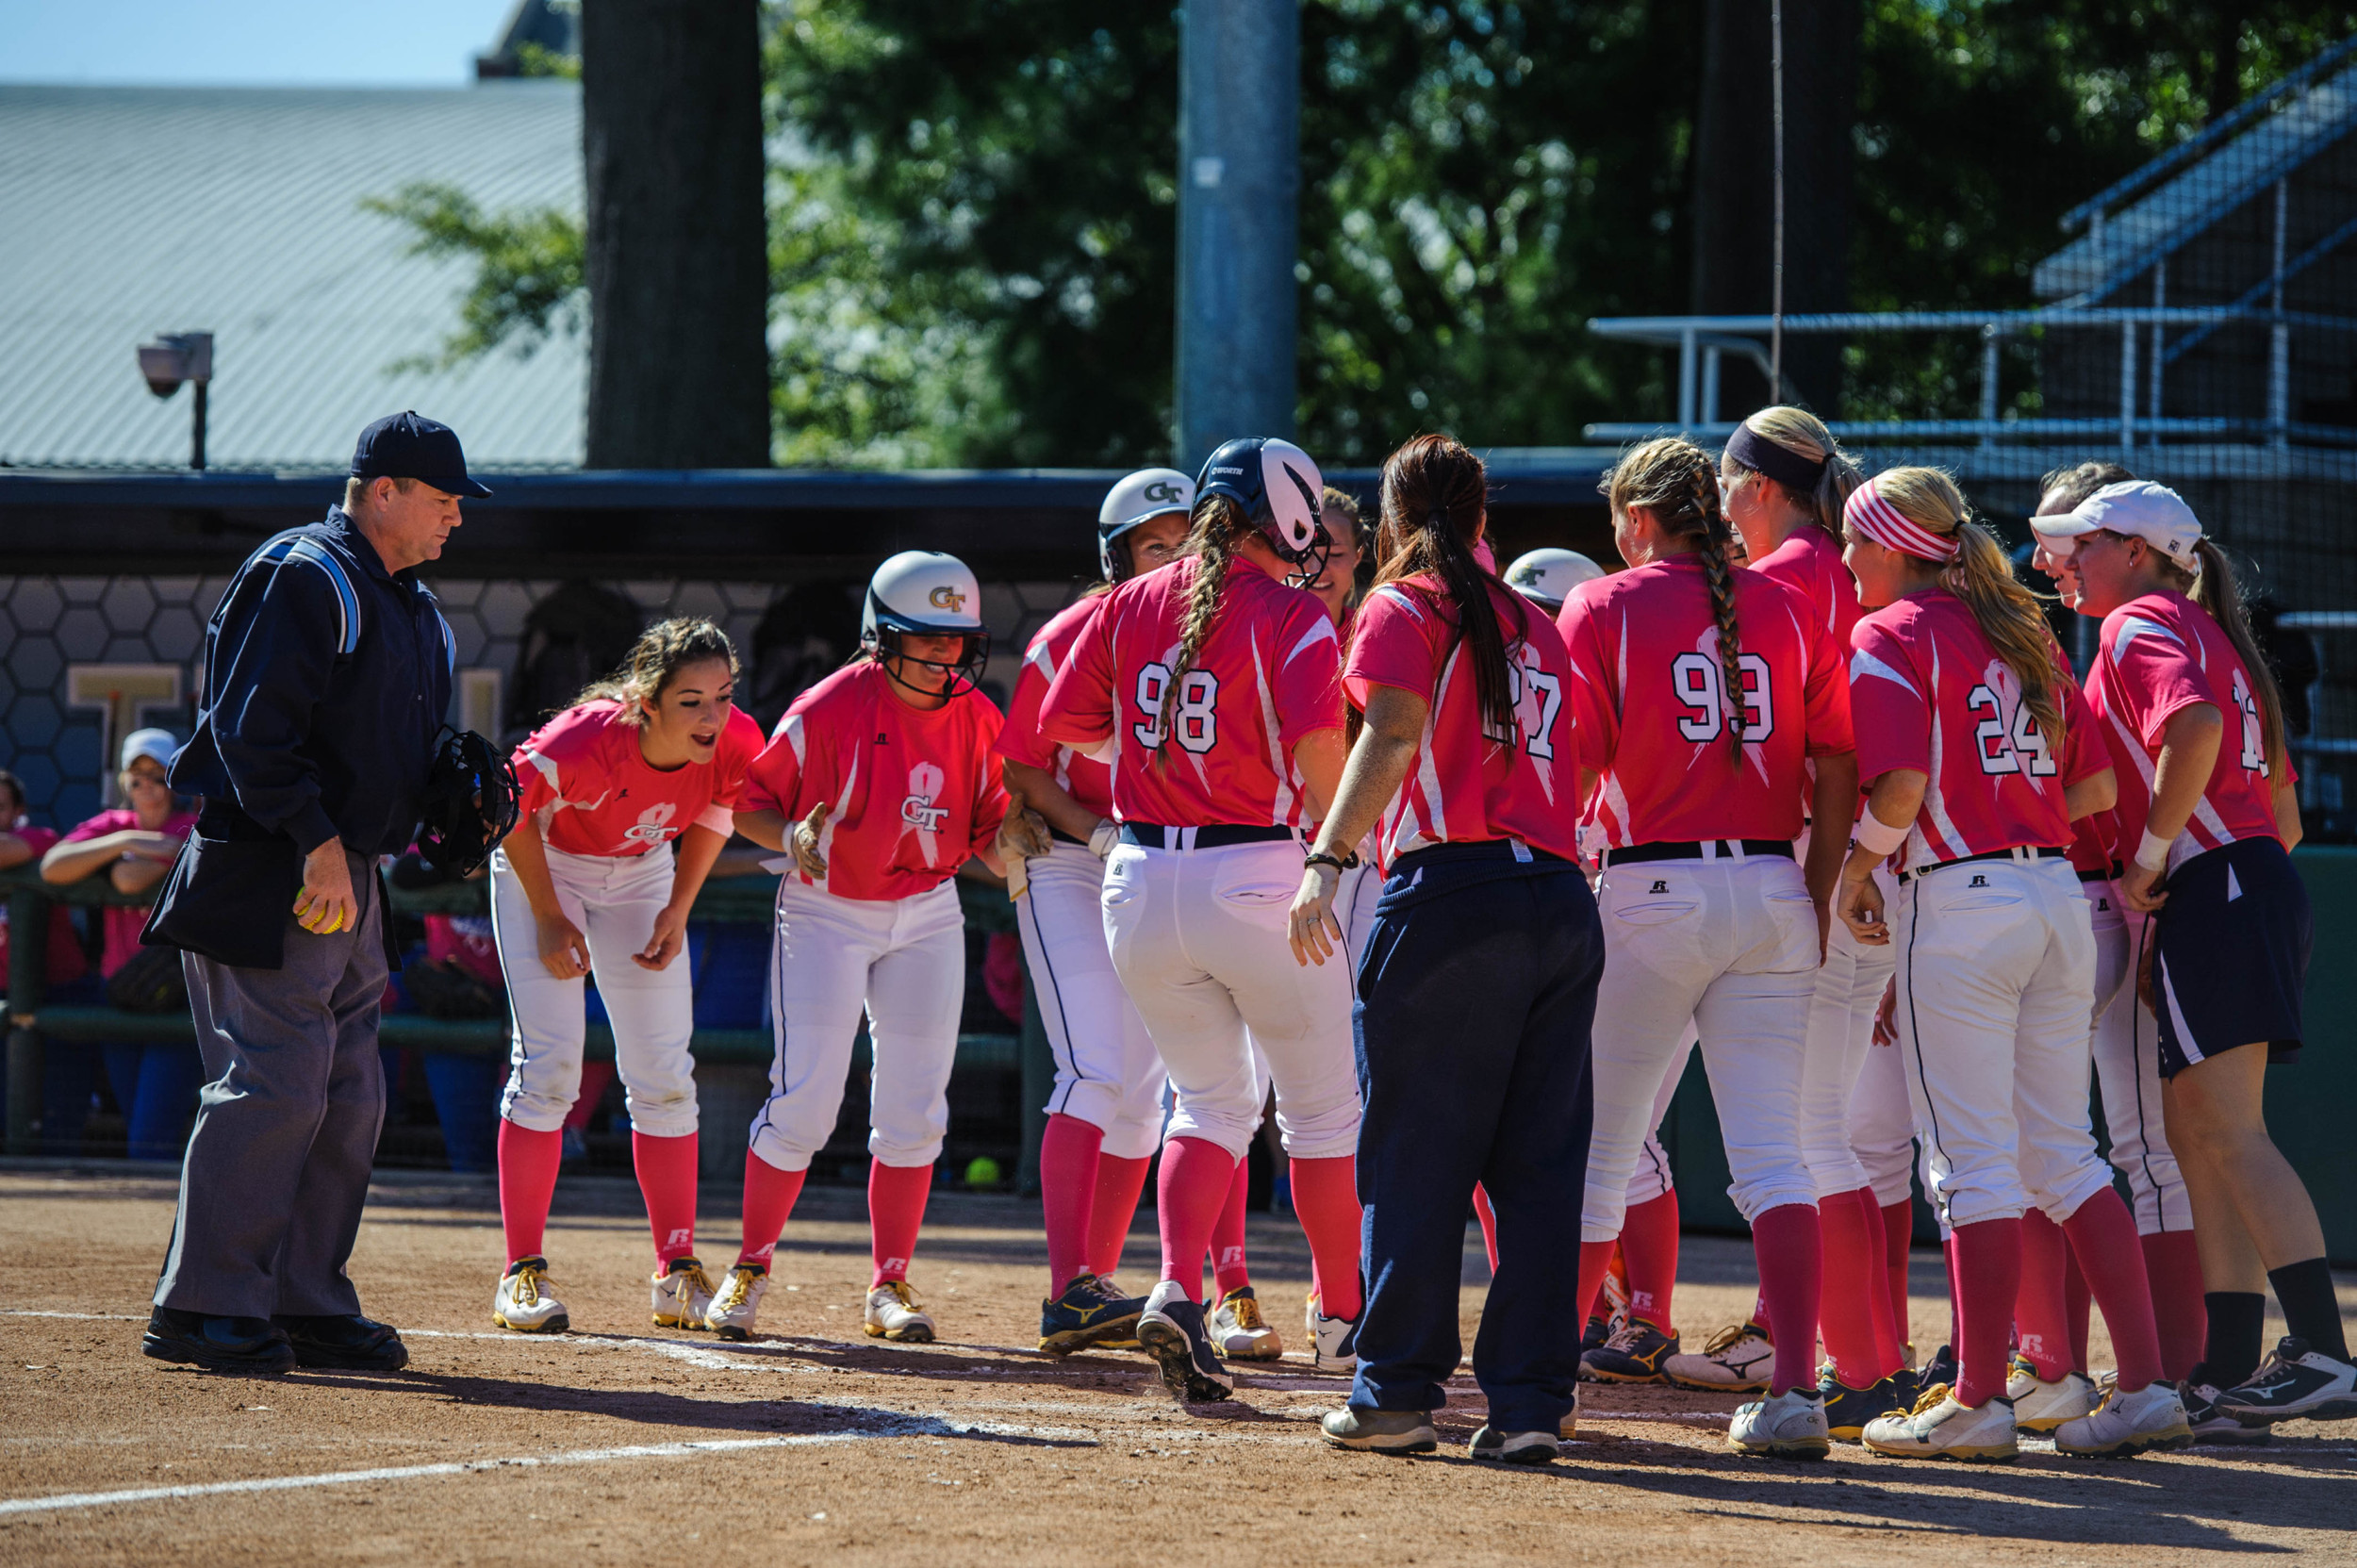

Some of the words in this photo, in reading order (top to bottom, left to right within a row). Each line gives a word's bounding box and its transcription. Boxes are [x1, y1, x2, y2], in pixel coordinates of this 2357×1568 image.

[1217, 467, 1244, 475] WORTH
[1144, 481, 1184, 503] GT
[1511, 563, 1545, 586] GT
[929, 586, 965, 613] GT
[1133, 661, 1220, 754] 98
[1671, 652, 1775, 743] 99
[1966, 685, 2057, 777] 24
[900, 795, 950, 832] GT
[668, 1229, 690, 1245] R
[882, 1257, 906, 1270] R
[1221, 1246, 1242, 1264] R
[1632, 1290, 1653, 1307] R
[2021, 1333, 2043, 1353] R
